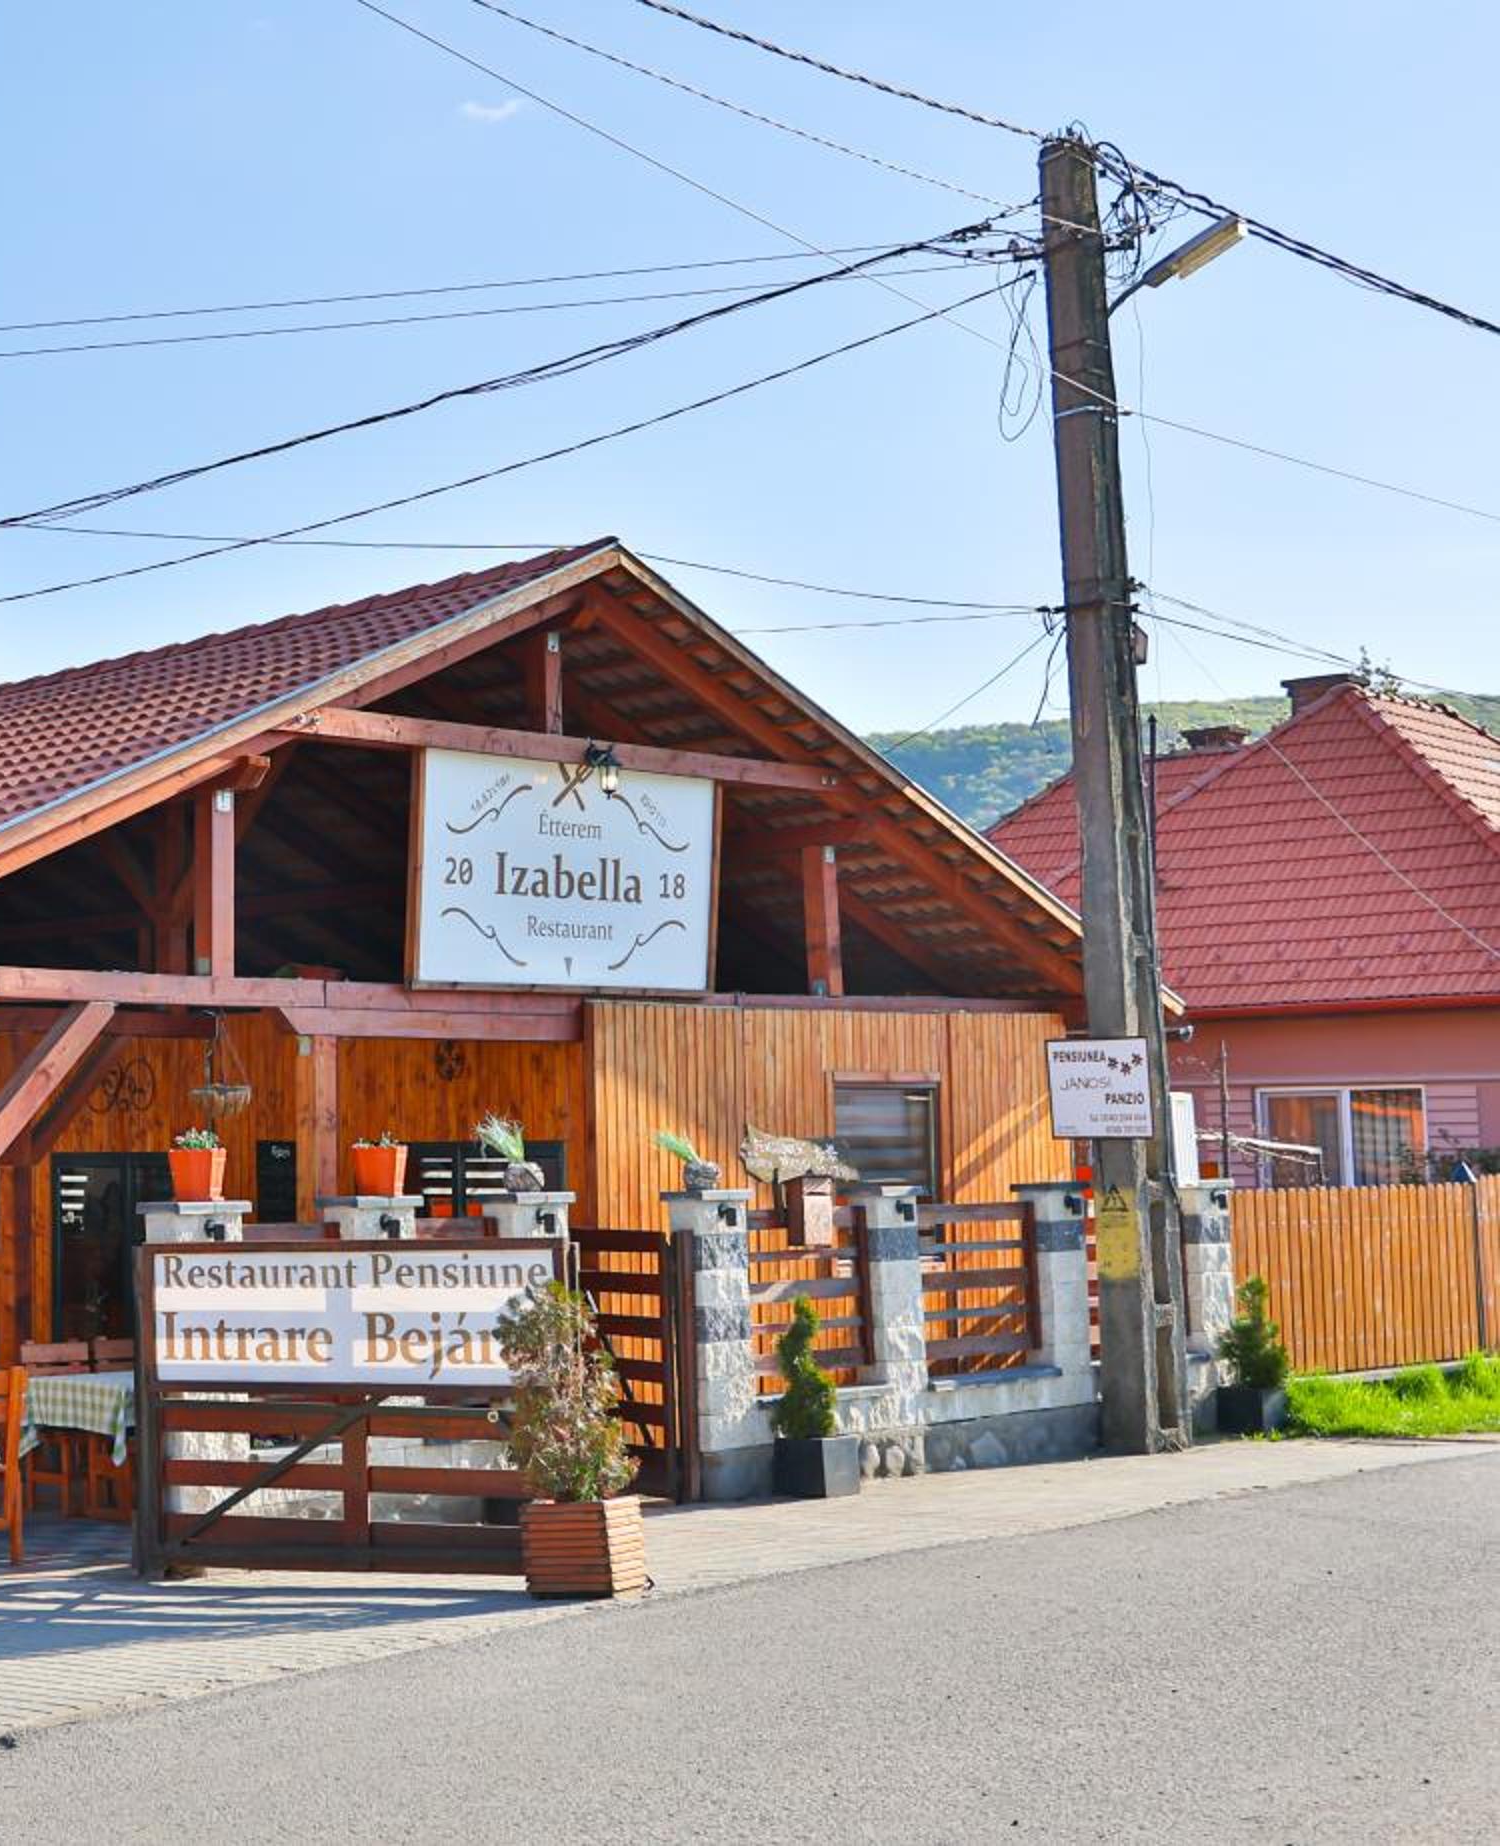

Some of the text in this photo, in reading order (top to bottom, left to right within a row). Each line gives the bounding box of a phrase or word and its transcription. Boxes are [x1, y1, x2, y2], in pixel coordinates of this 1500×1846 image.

[444, 851, 686, 904] 20 Izabella 18
[526, 915, 614, 941] Restaurant
[1052, 1050, 1107, 1064] PENSIUNEA
[161, 1253, 548, 1290] Restaurant Pensiune
[161, 1311, 510, 1380] Intrare Bejár
